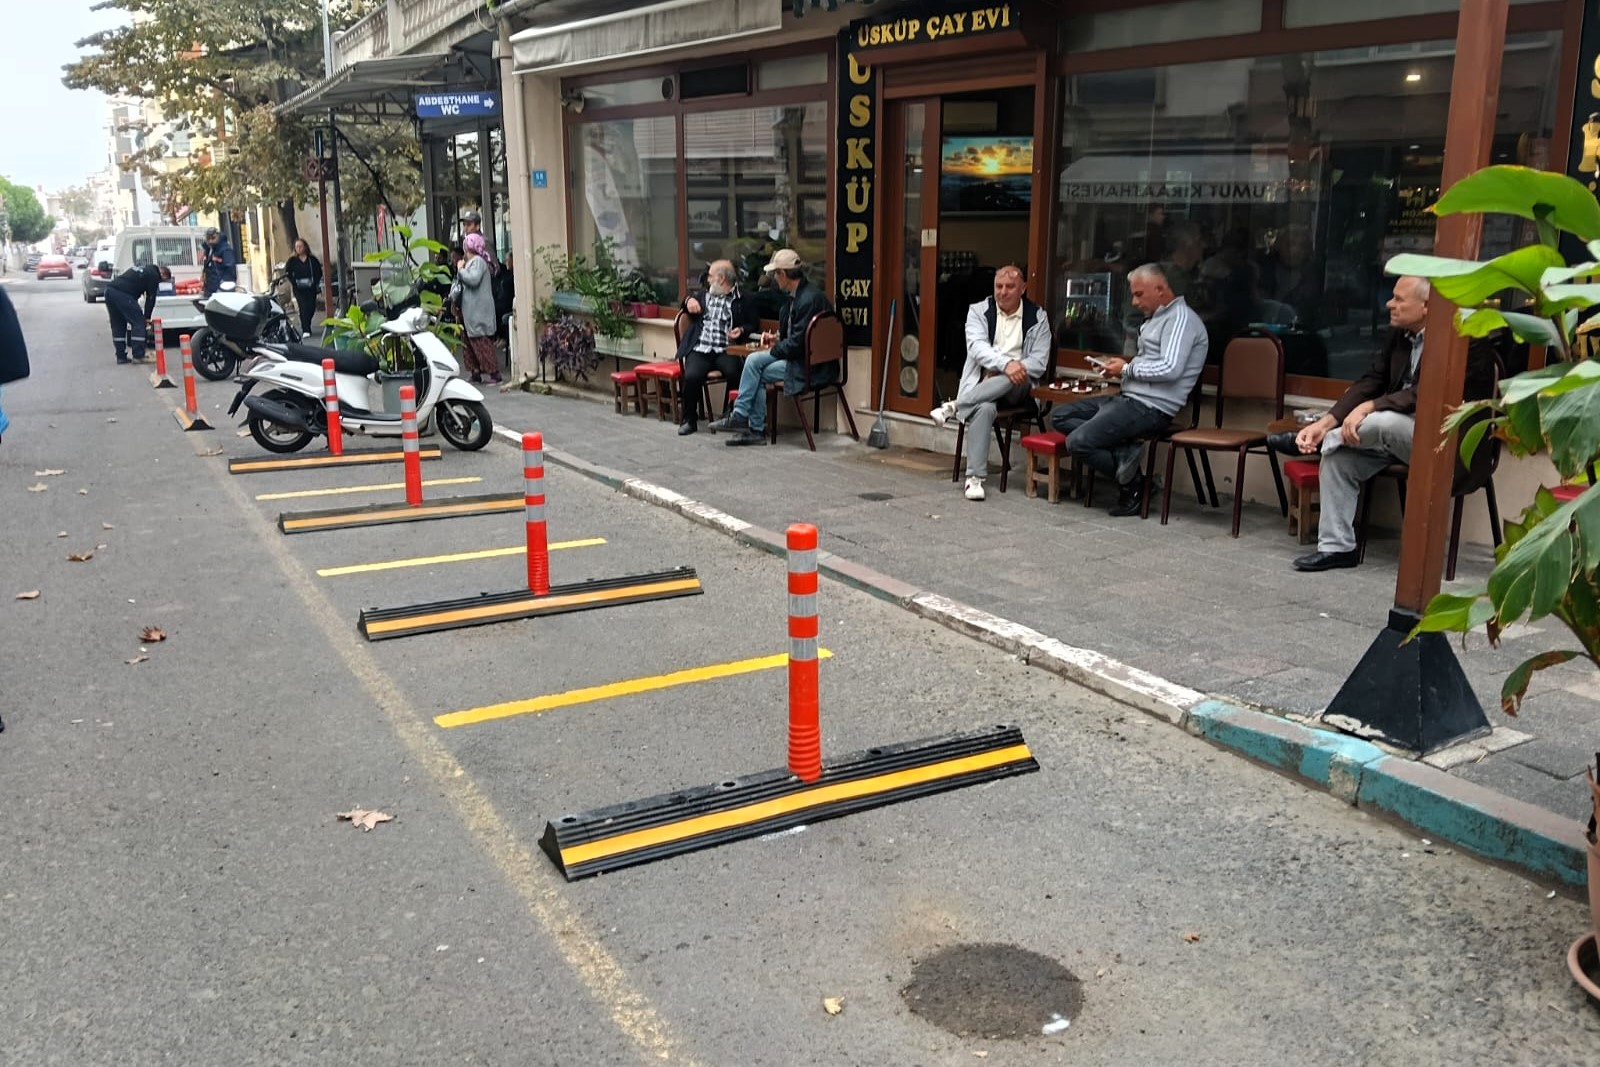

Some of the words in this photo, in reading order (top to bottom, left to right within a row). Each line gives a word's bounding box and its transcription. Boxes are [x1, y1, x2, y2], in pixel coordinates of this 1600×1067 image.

[926, 13, 966, 40] ÇAY
[971, 4, 1010, 32] EVİ
[441, 104, 460, 115] WC
[840, 278, 871, 300] ÇAY
